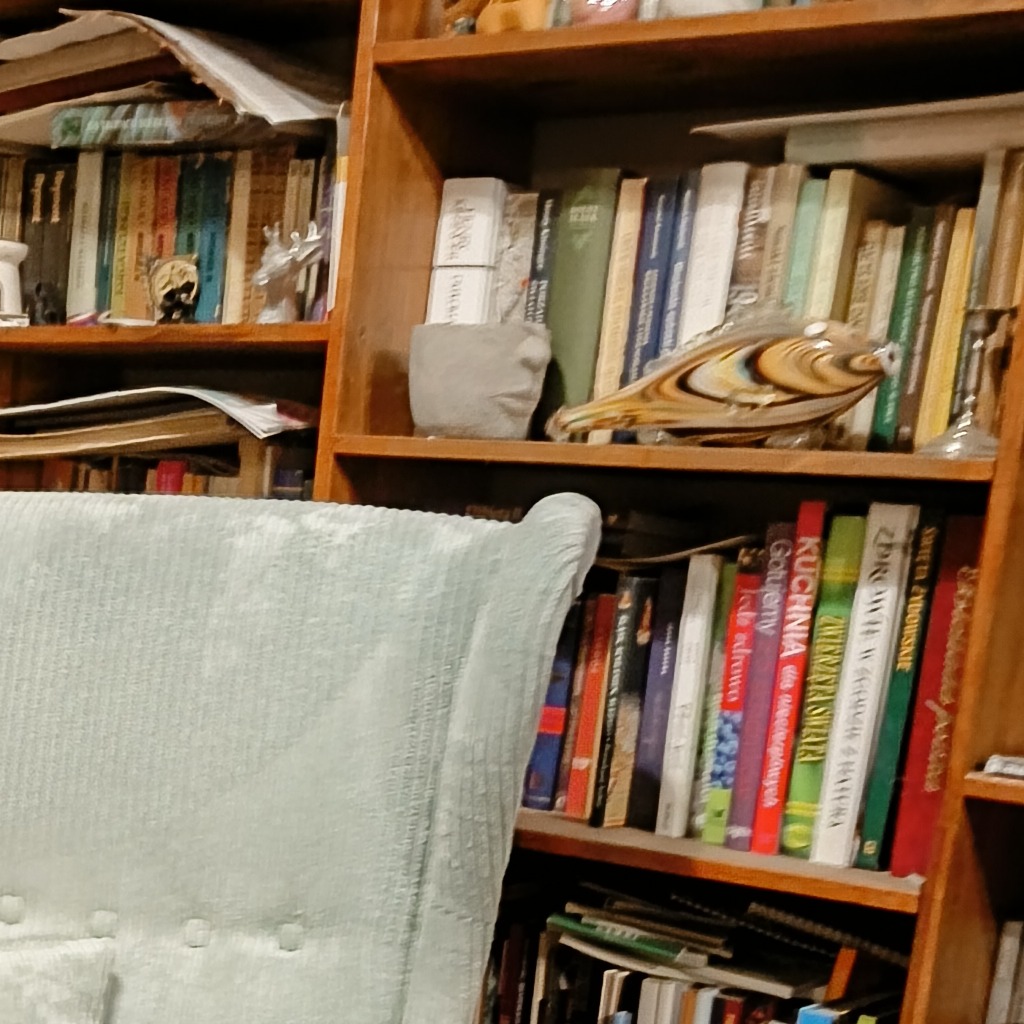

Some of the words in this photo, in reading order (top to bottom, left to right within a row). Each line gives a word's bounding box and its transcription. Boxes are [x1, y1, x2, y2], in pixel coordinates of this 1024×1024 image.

[755, 539, 793, 636] Gotujemy
[780, 536, 822, 658] KUCHNIA
[896, 585, 928, 672] ŻYDOWSKIE
